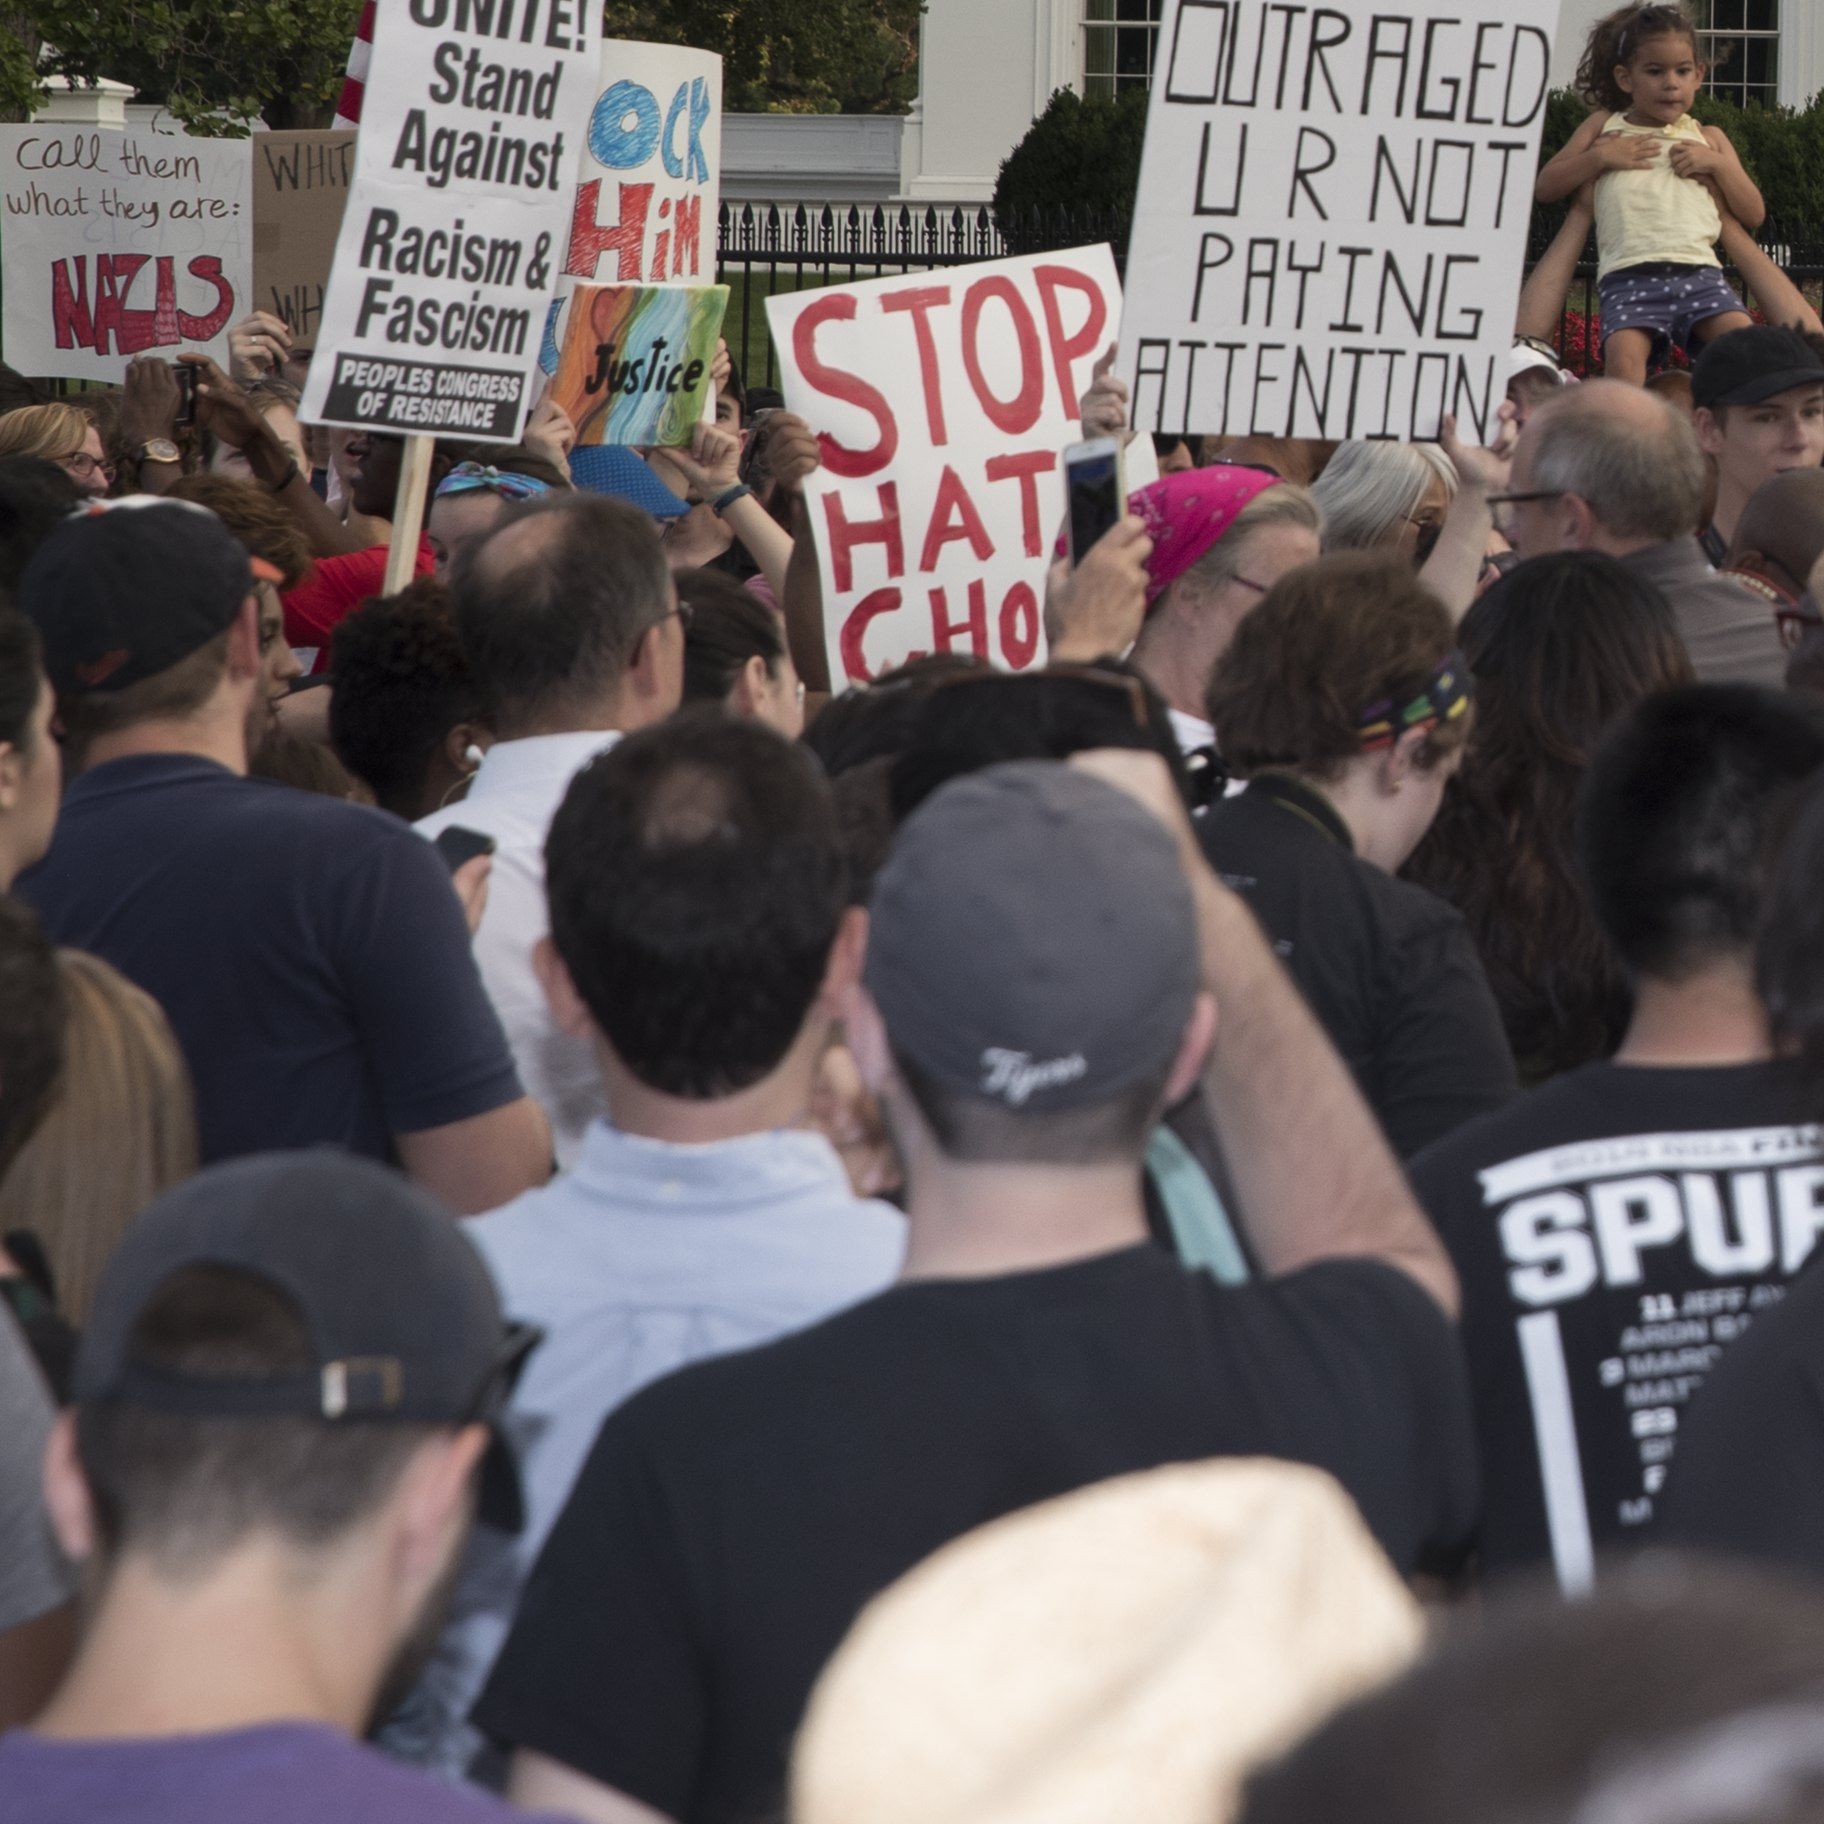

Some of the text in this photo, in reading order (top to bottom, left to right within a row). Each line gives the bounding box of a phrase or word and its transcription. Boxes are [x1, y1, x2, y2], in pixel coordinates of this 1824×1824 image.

[428, 40, 564, 121] Stand
[119, 138, 201, 183] them
[263, 141, 357, 192] WHIT
[391, 108, 565, 192] Against
[588, 76, 712, 186] OCK
[6, 180, 241, 229] what they are:
[1193, 121, 1528, 230] U R NOT
[359, 207, 552, 292] Racism &
[1190, 231, 1484, 341] PAYING
[51, 252, 236, 356] NAZIS
[354, 276, 531, 356] Fascism
[337, 358, 521, 403] PEOPLES CONGRESS
[356, 390, 497, 428] OF RESISTANCE
[791, 264, 1108, 479] STOP
[1130, 336, 1495, 446] ATTENTION
[821, 450, 1057, 594] HAT
[840, 578, 1040, 683] CHO
